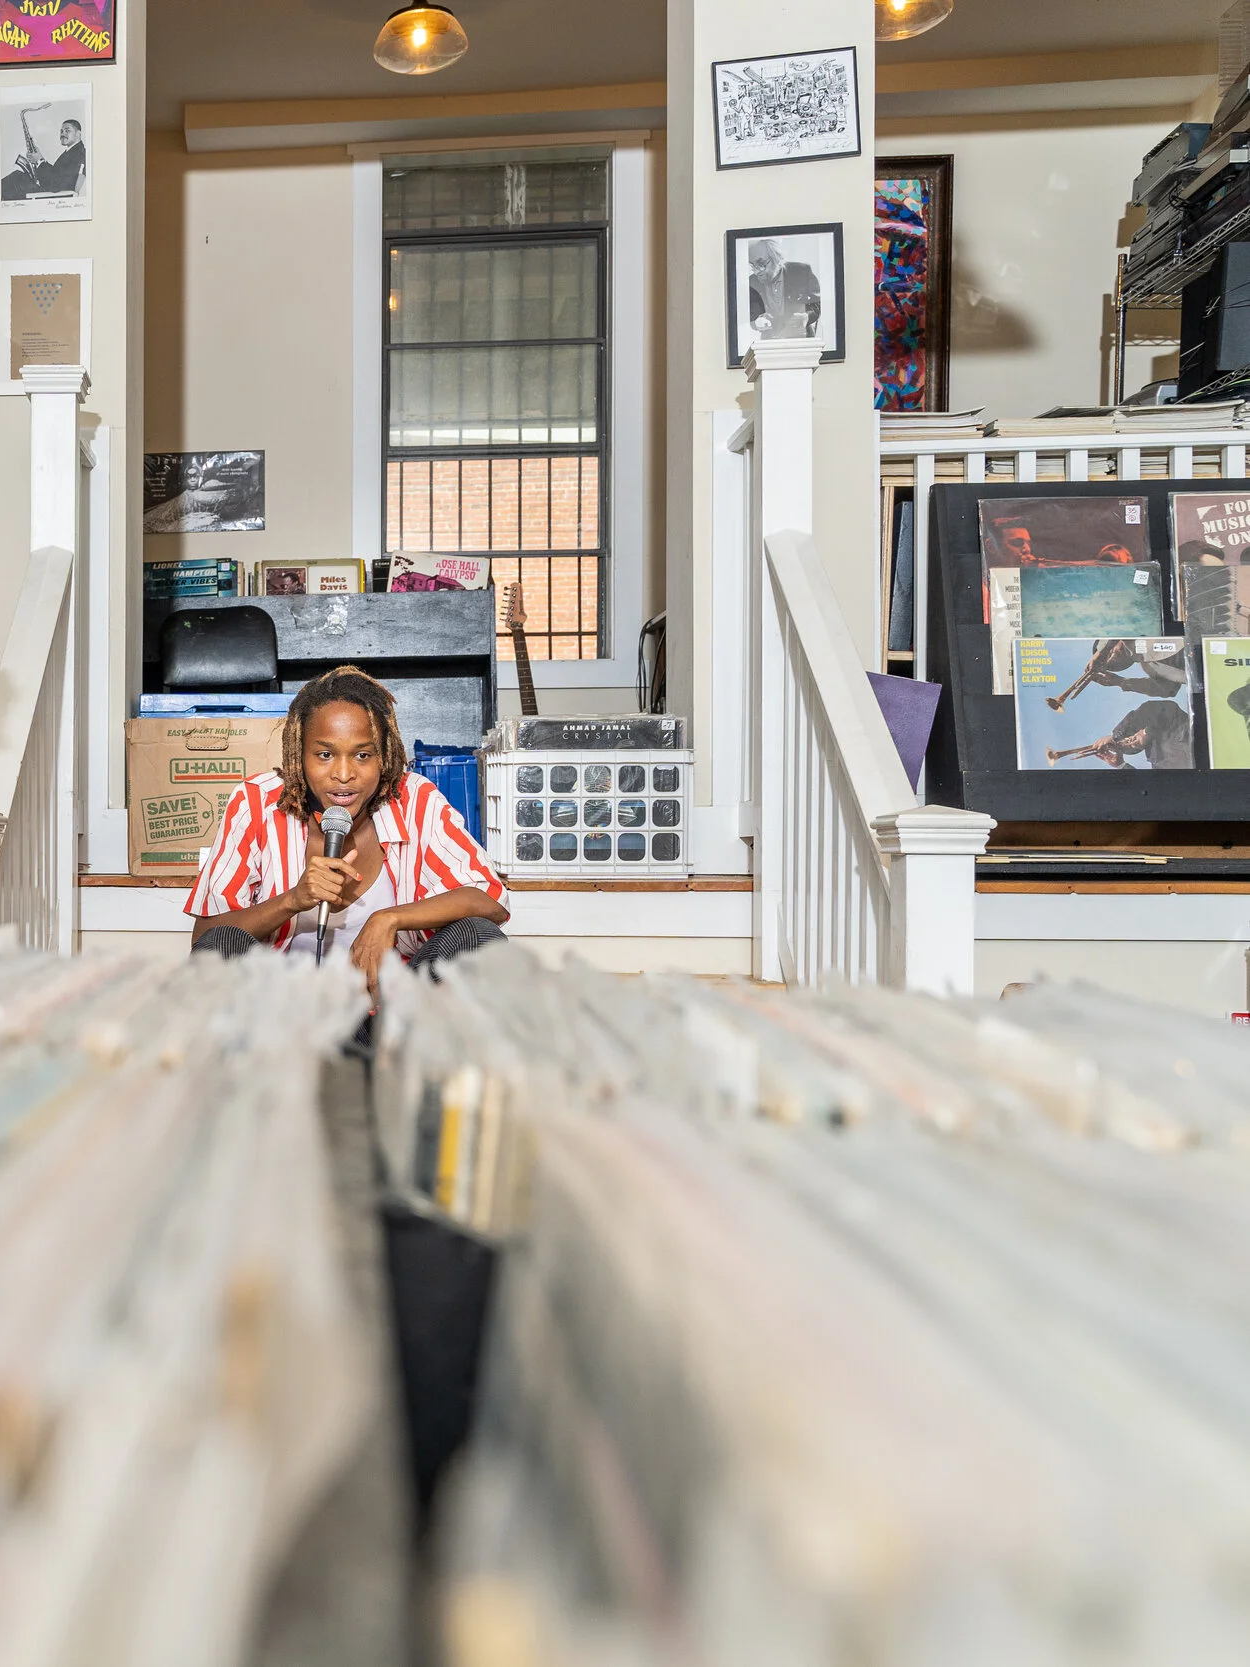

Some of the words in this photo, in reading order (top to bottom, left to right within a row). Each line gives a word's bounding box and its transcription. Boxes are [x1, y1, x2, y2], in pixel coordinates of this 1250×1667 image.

[50, 18, 111, 53] RHYTHMS
[152, 562, 183, 570] LIONEL
[459, 560, 480, 571] HALL
[173, 568, 217, 577] HAMPTON
[439, 569, 476, 580] CALYPSO
[562, 732, 631, 740] CRYSTAL
[175, 762, 241, 773] U-HAUL
[147, 797, 197, 816] SAVE!
[150, 820, 170, 830] BEST
[173, 816, 198, 827] PRICE
[150, 826, 200, 840] GUARANTEED
